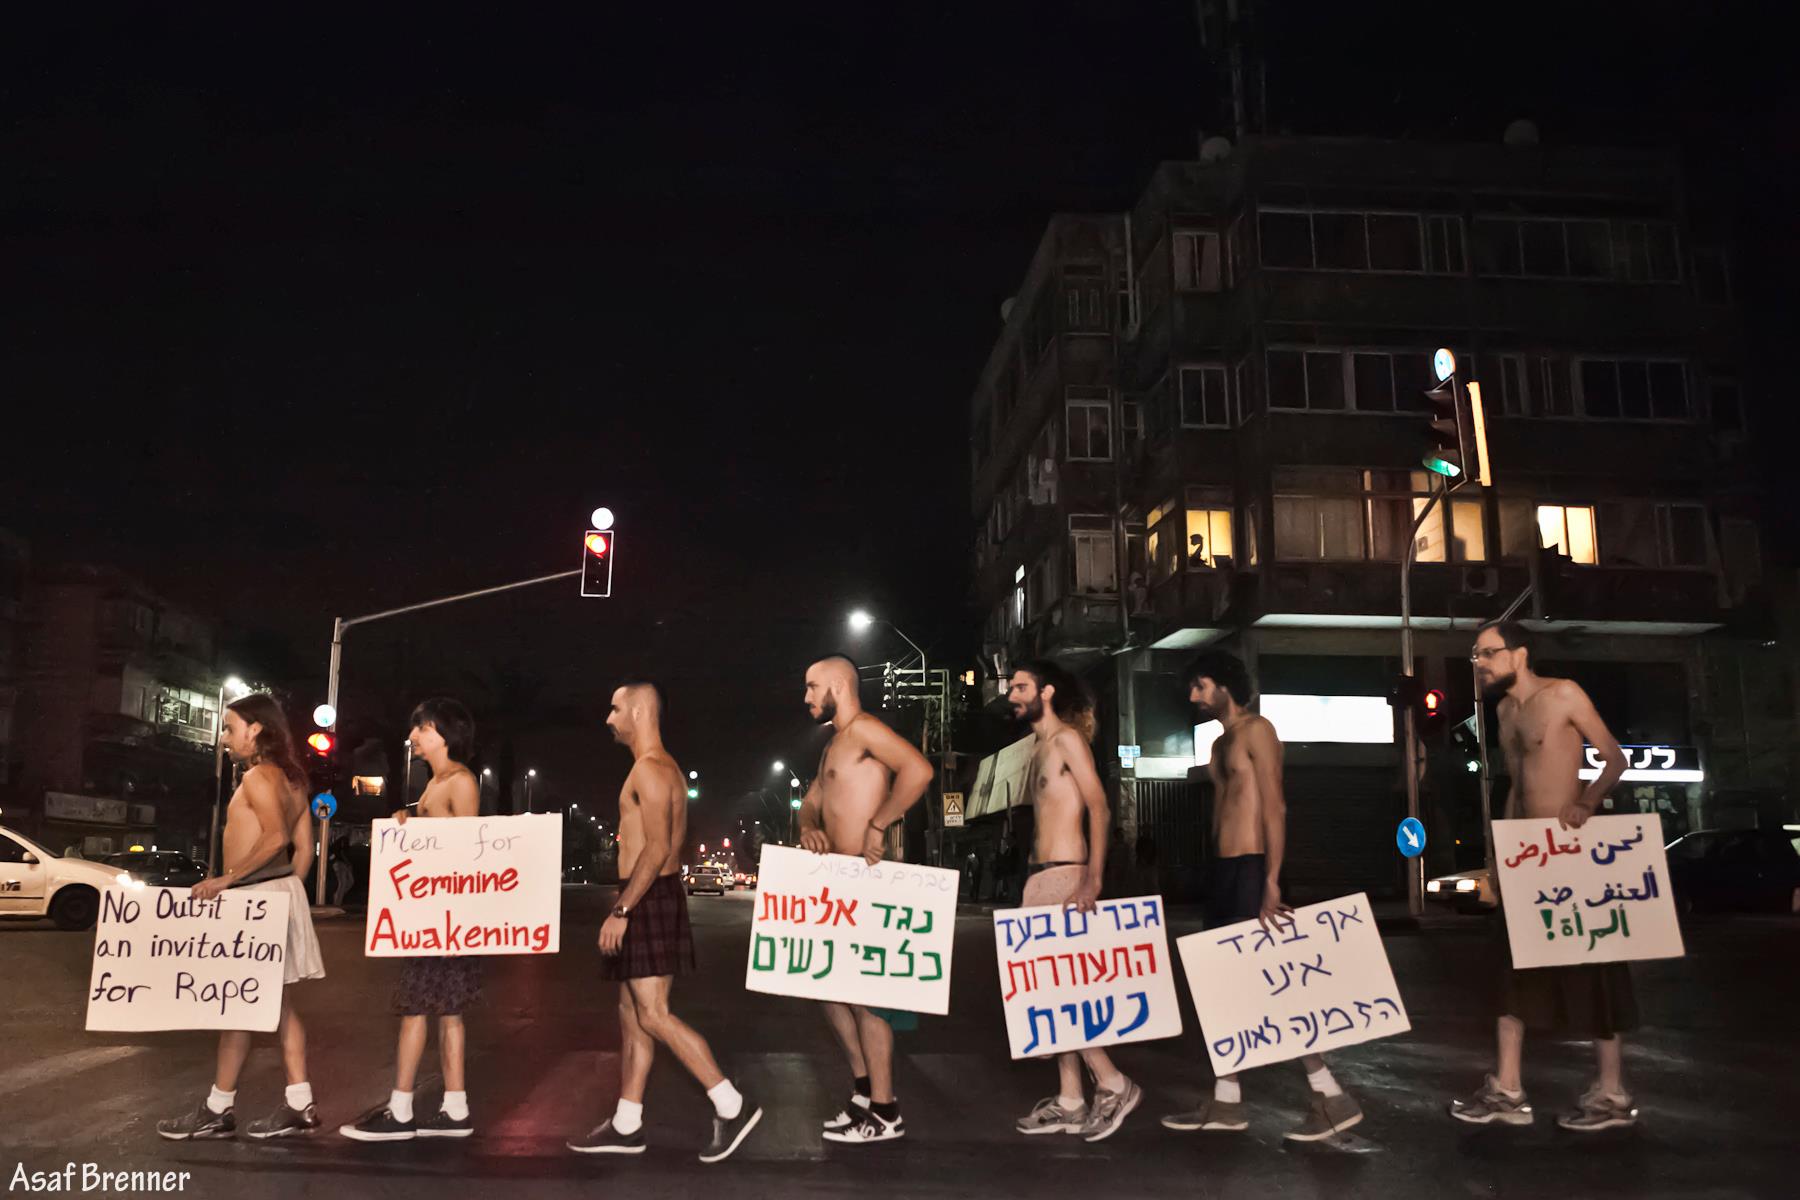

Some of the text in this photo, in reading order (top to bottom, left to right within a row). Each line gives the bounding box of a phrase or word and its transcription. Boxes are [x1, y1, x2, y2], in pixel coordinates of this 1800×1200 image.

[379, 823, 522, 861] Men for
[1504, 825, 1643, 868] نحن نعارض
[389, 858, 519, 900] Feminine
[889, 868, 954, 891] גברים
[1534, 886, 1573, 906] ضد
[102, 888, 267, 923] No Outfit is
[758, 886, 933, 934] נגד אלימות
[996, 900, 1160, 953] גברים בעד
[97, 930, 283, 963] an invitation
[370, 907, 550, 952] Awakening
[1217, 905, 1363, 954] אף בגד
[752, 932, 942, 981] כלפי נשים
[1004, 942, 1157, 1003] התעוררות
[1262, 954, 1332, 996] אינו
[91, 971, 260, 1016] for Rape
[1023, 992, 1150, 1055] נשית
[1213, 997, 1401, 1068] הזמנה לאונס
